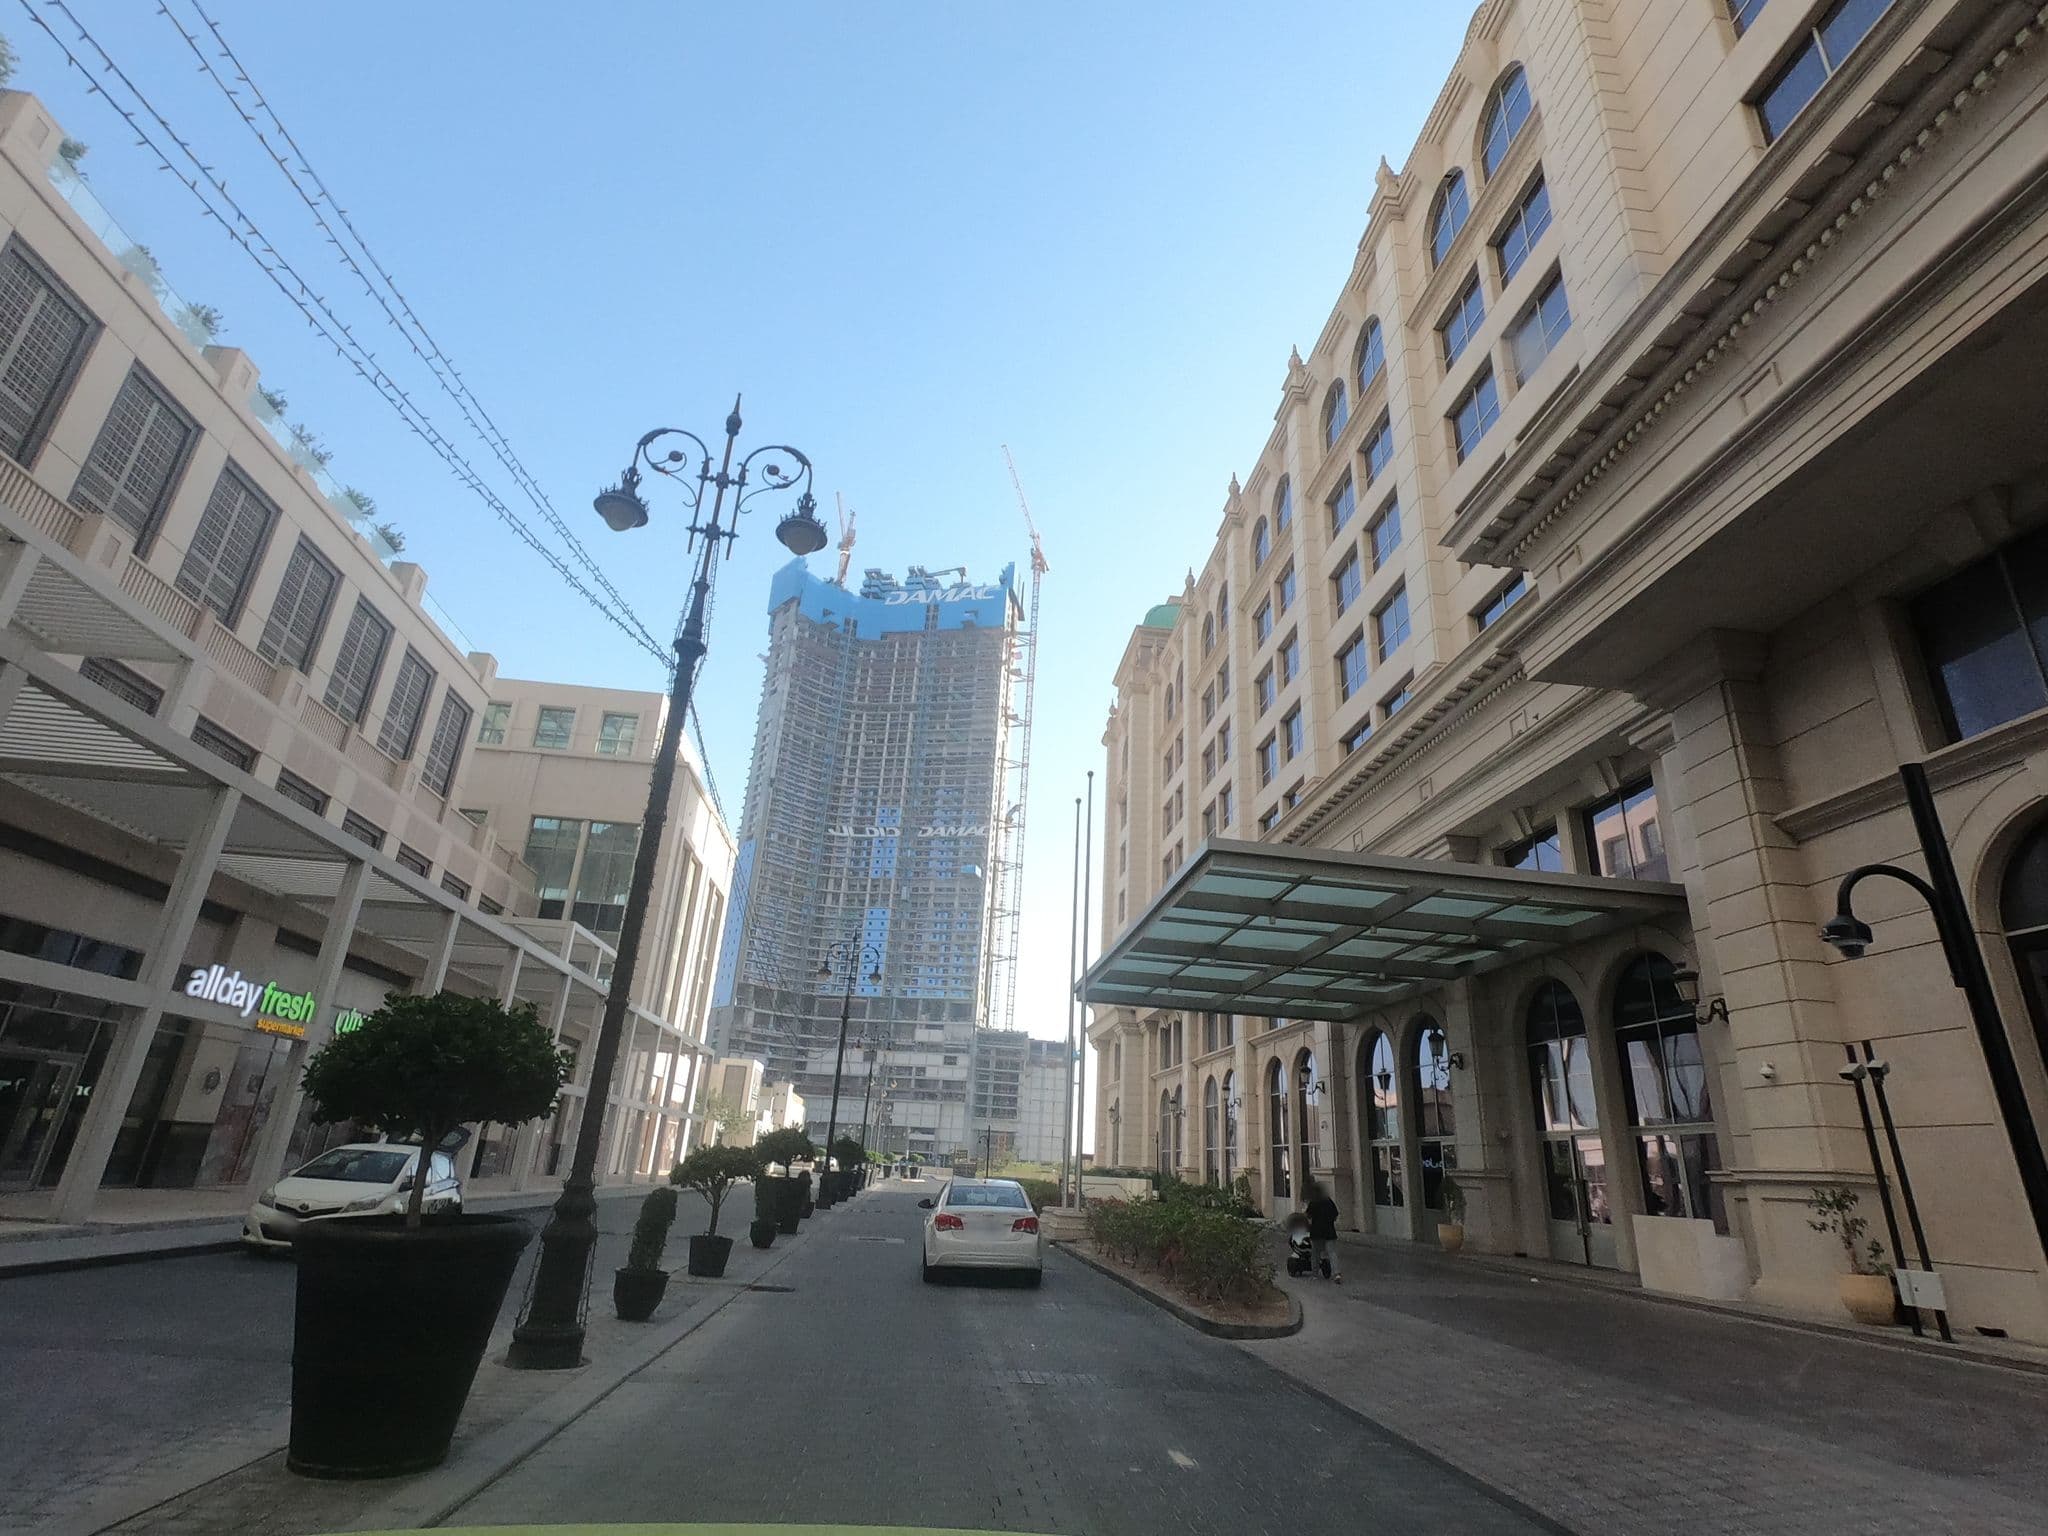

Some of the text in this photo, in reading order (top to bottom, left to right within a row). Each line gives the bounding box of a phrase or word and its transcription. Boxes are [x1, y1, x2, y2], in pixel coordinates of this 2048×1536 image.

[885, 586, 995, 605] DAMAC
[917, 826, 990, 837] DAMAC
[186, 964, 263, 1018] allday
[260, 981, 315, 1023] fresh
